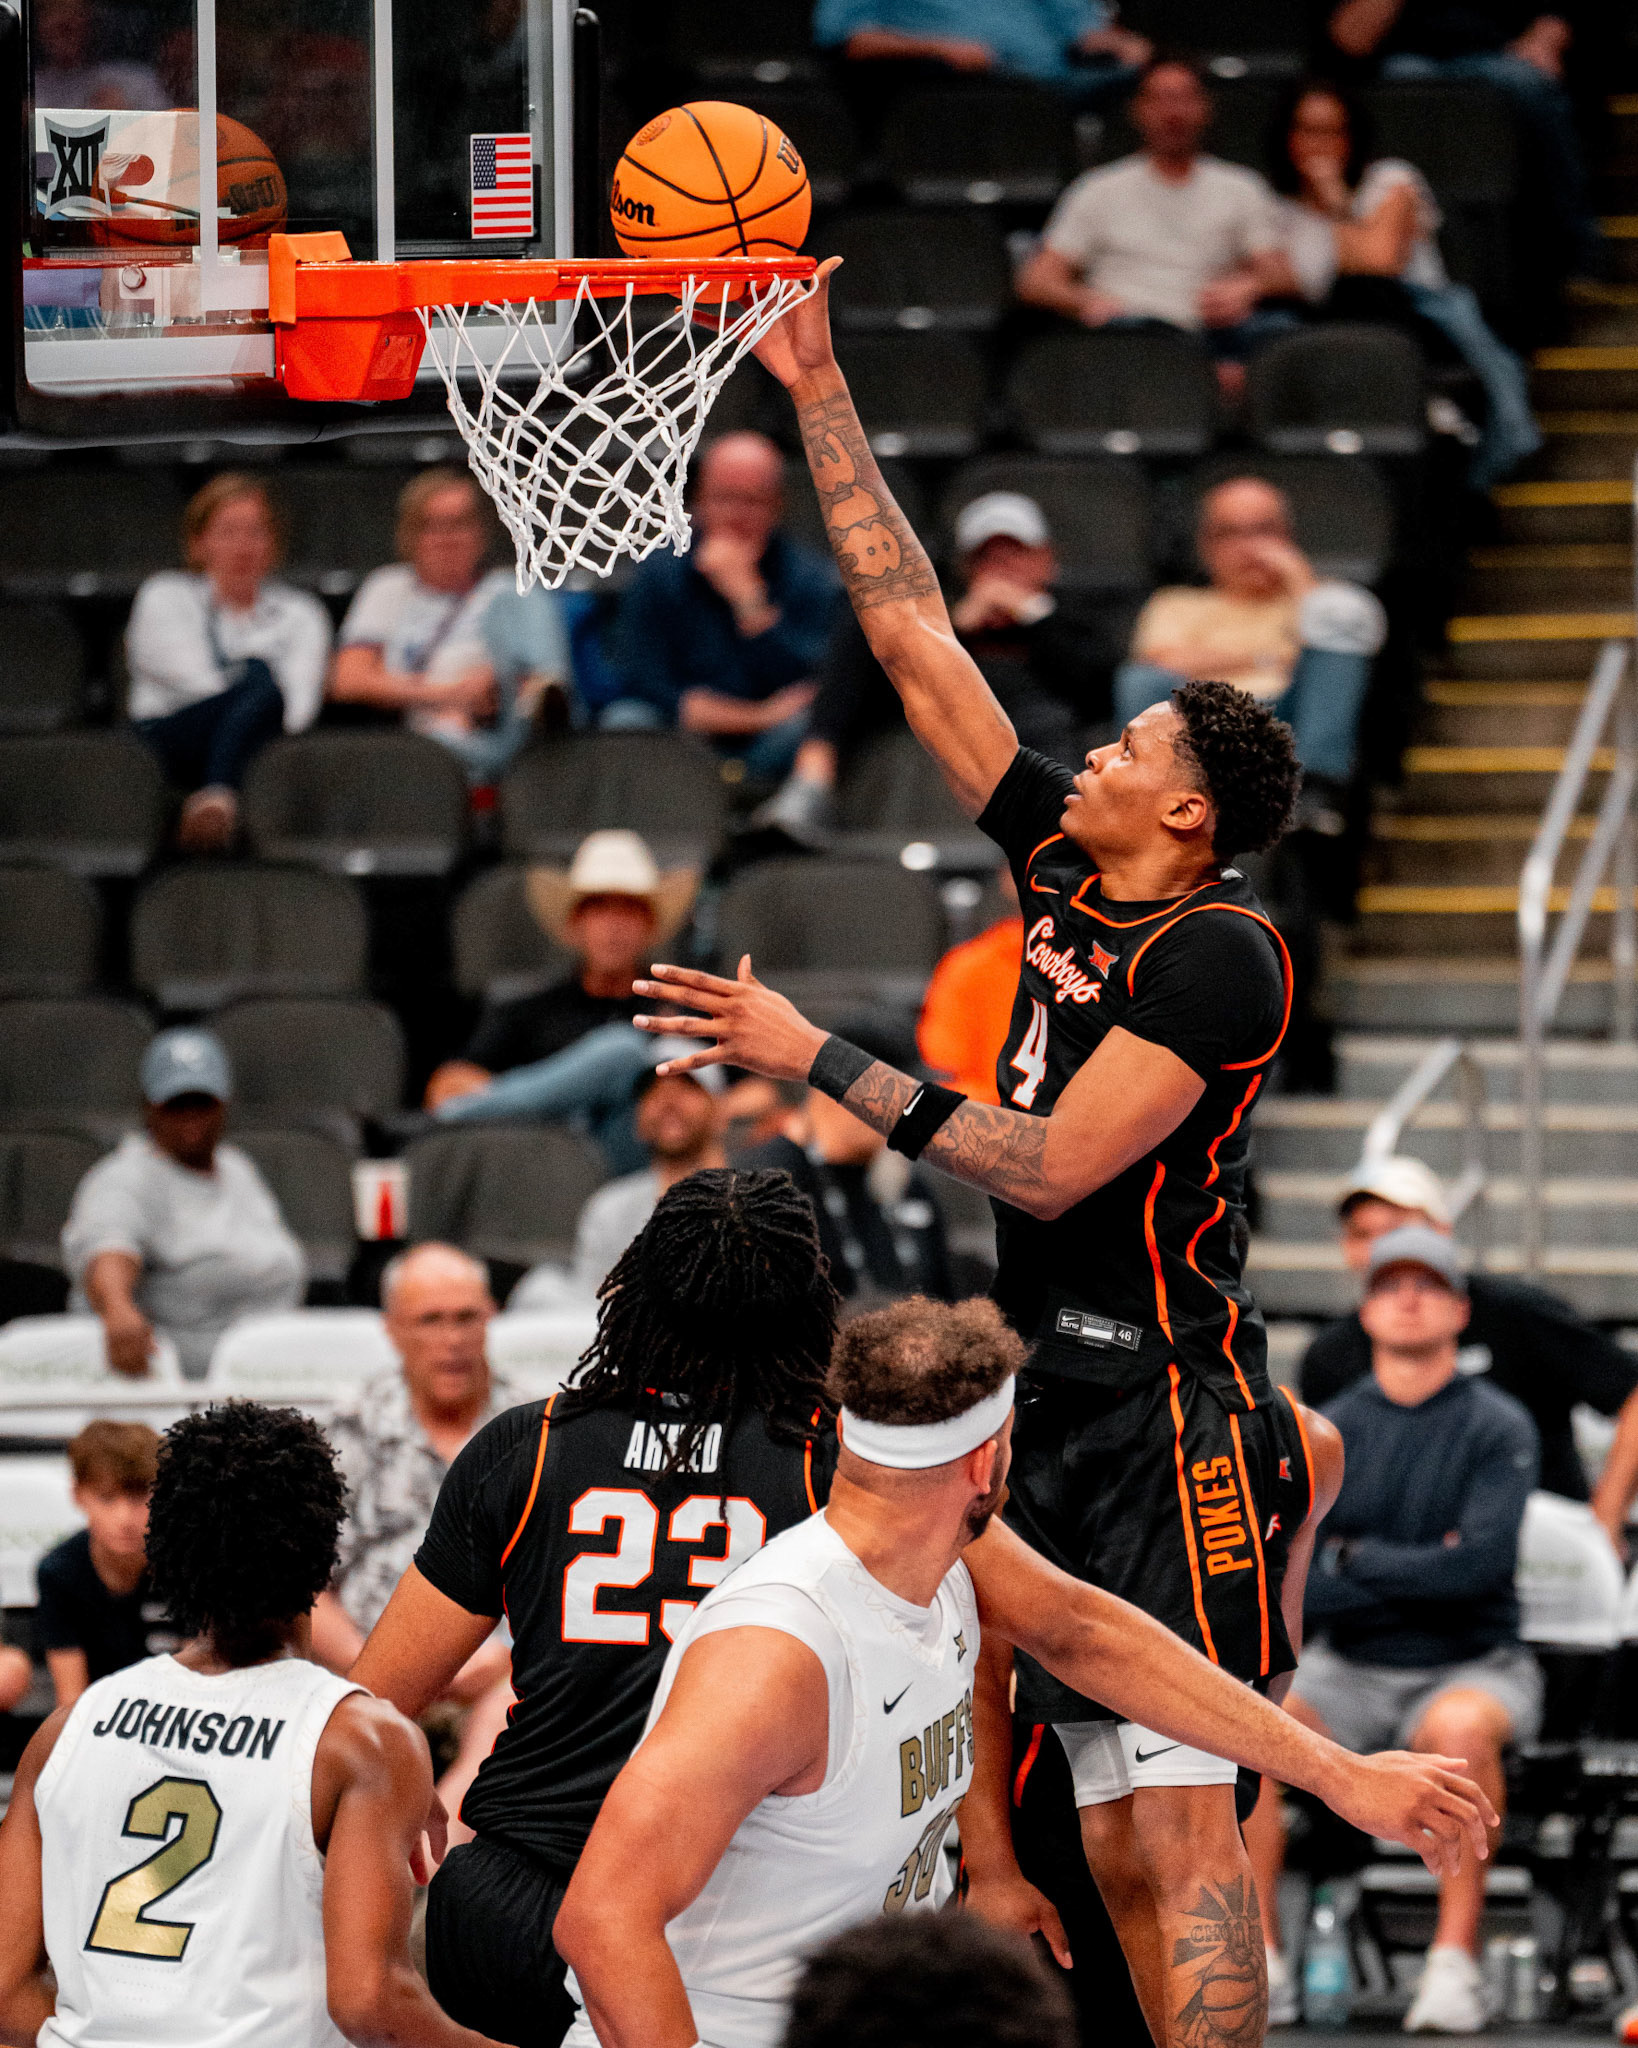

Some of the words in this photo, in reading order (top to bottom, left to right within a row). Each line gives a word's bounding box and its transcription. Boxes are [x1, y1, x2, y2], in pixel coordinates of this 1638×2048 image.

[48, 120, 108, 210] XII
[610, 179, 656, 227] lson
[1026, 915, 1102, 1004] Cowboys
[1009, 997, 1048, 1110] 4
[1117, 1328, 1132, 1342] 46
[1191, 1455, 1253, 1577] POKES
[561, 1487, 767, 1645] 23
[93, 1698, 286, 1760] JOHNSON
[84, 1775, 223, 1963] 2
